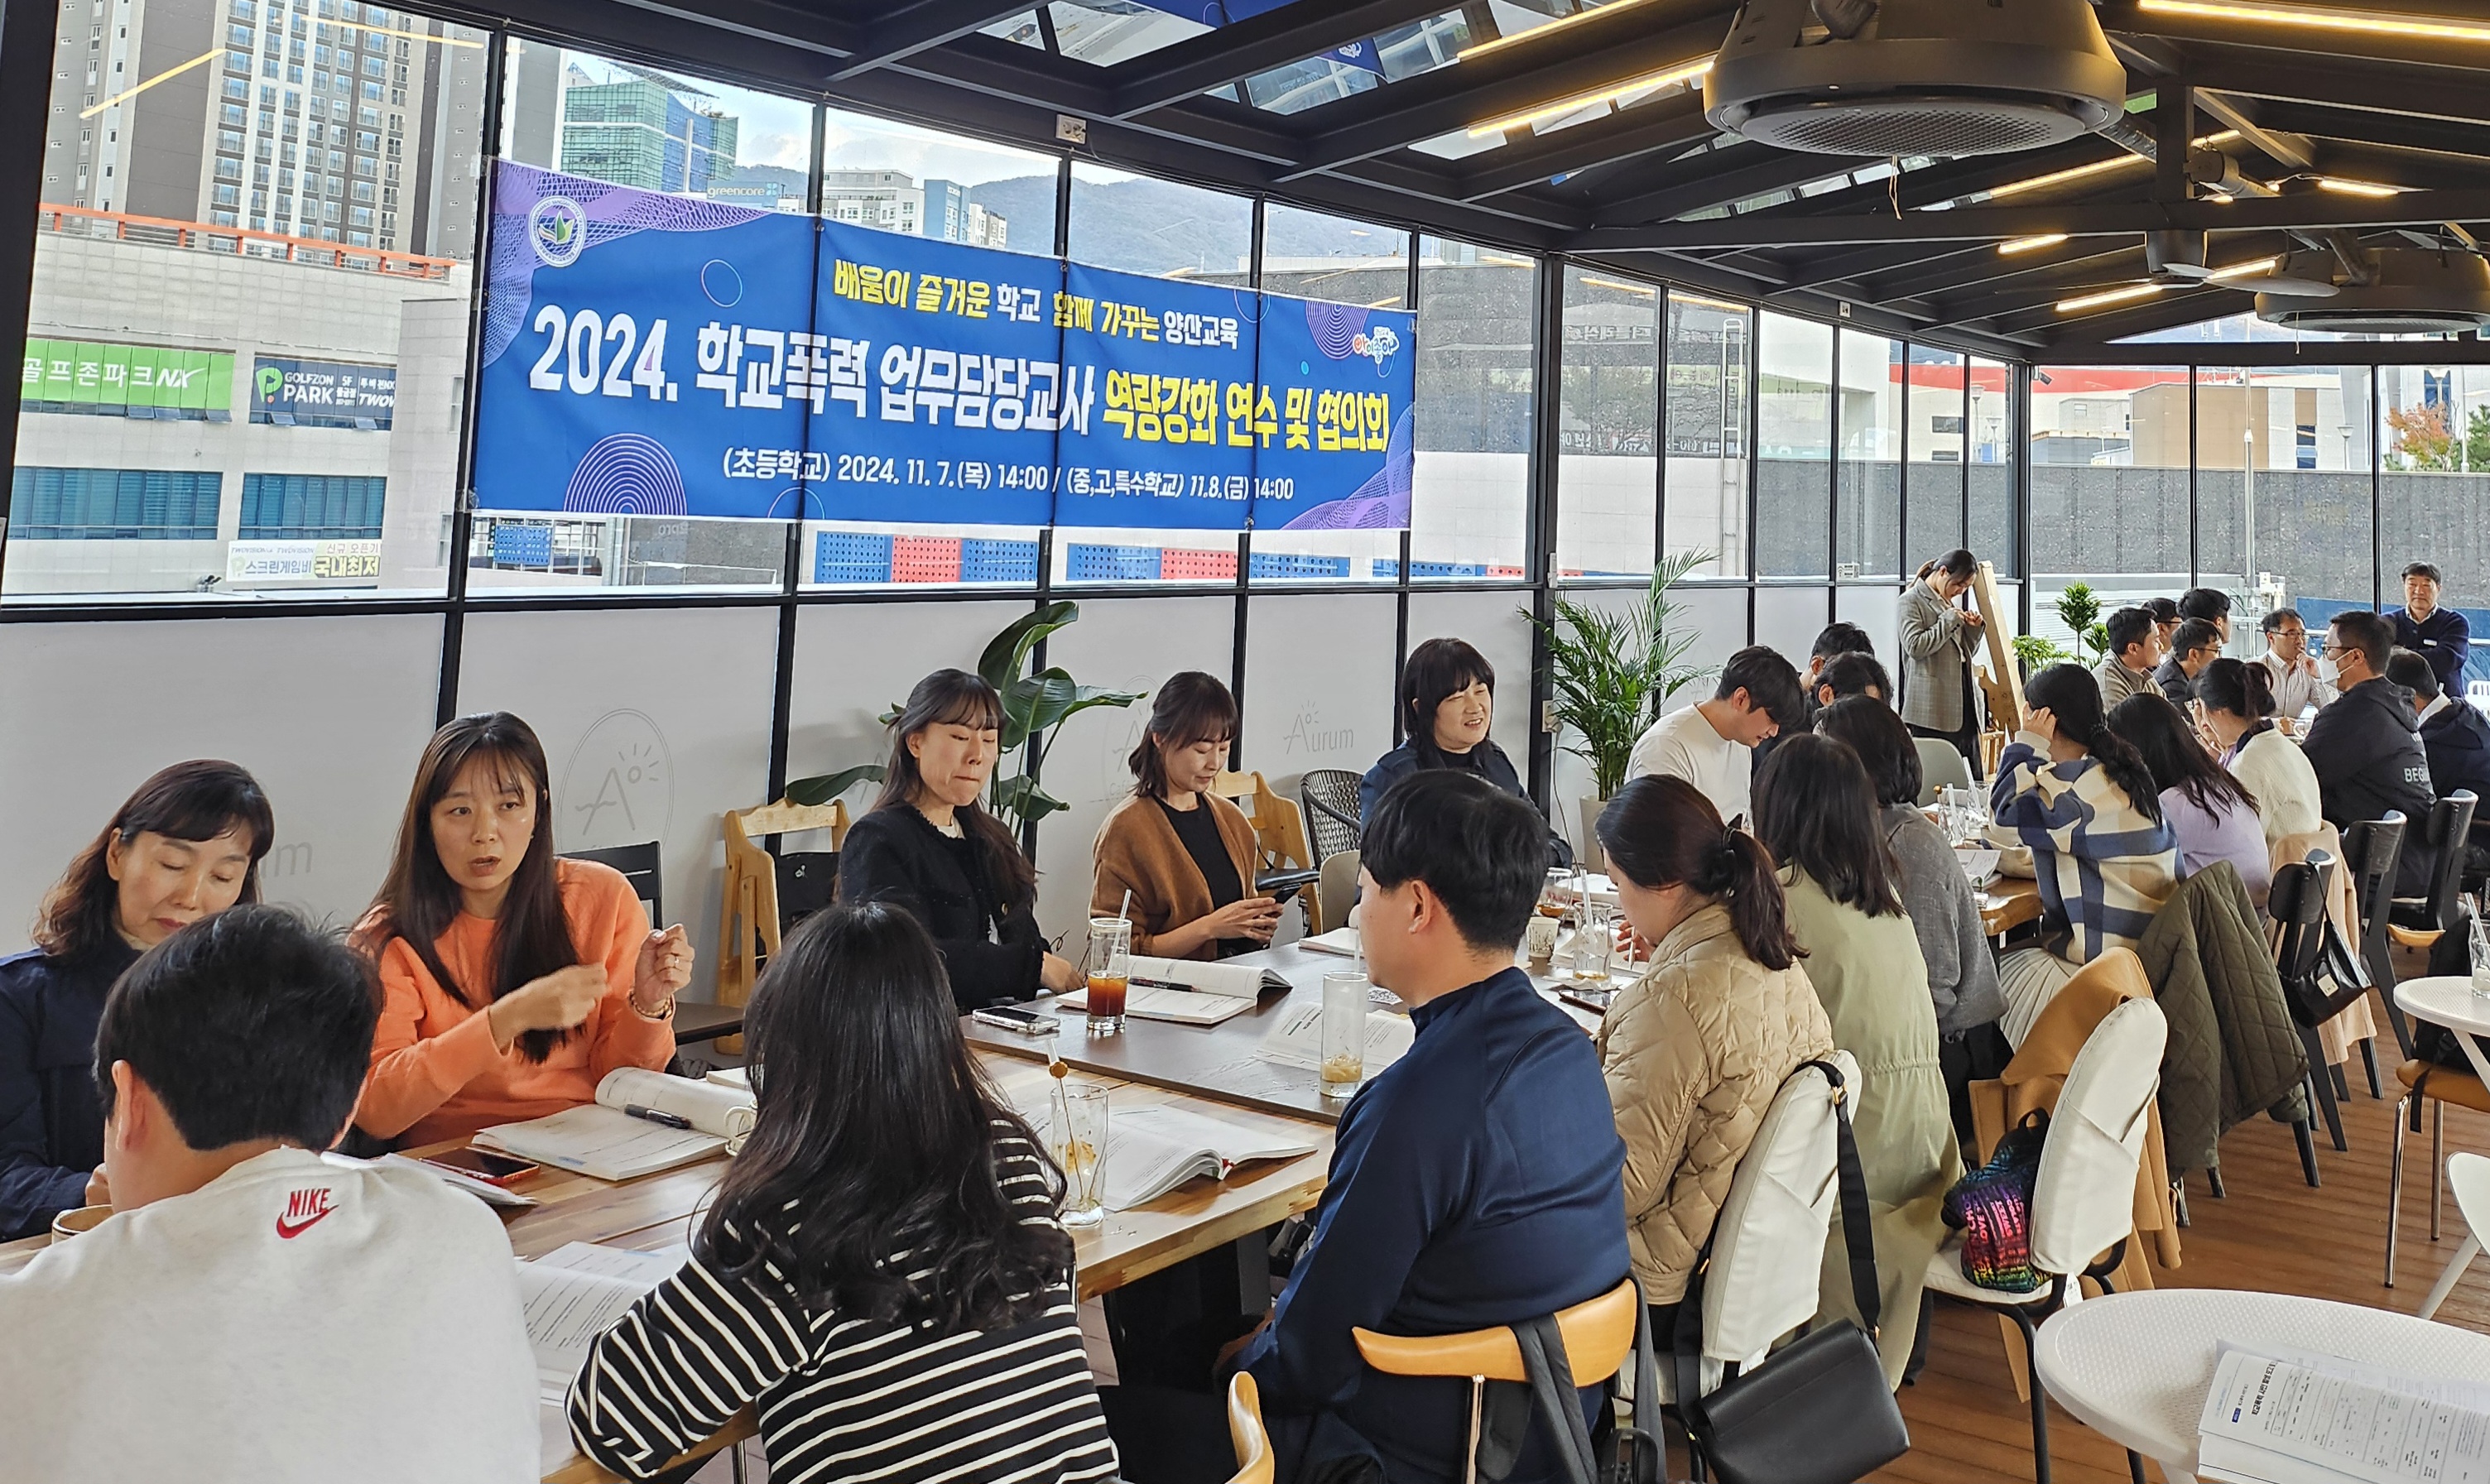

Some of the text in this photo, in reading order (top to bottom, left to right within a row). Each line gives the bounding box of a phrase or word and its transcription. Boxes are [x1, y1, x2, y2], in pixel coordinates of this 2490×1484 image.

[708, 187, 765, 199] greencore
[834, 258, 1239, 350] 배움이 즐거운 학교 함께 가꾸는 양산교육
[22, 358, 206, 388] 골프존파크NX
[285, 371, 334, 387] GOLFZON
[342, 375, 353, 387] 5F
[529, 304, 1391, 453] 2024. 학교폭력 업무담당교사 역량강화 연수 및 협의회
[283, 385, 334, 405] PARK
[723, 446, 1294, 501] (초등학교) 2024. 11. 7.(목) 14:00 / (중,고,특수학교) 11.8.(금) 14:00
[326, 543, 345, 555] 신규
[245, 560, 312, 574] 스크린게임비
[314, 555, 381, 579] 국내최저
[1283, 713, 1354, 755] Aurum
[286, 1187, 332, 1217] NIKE
